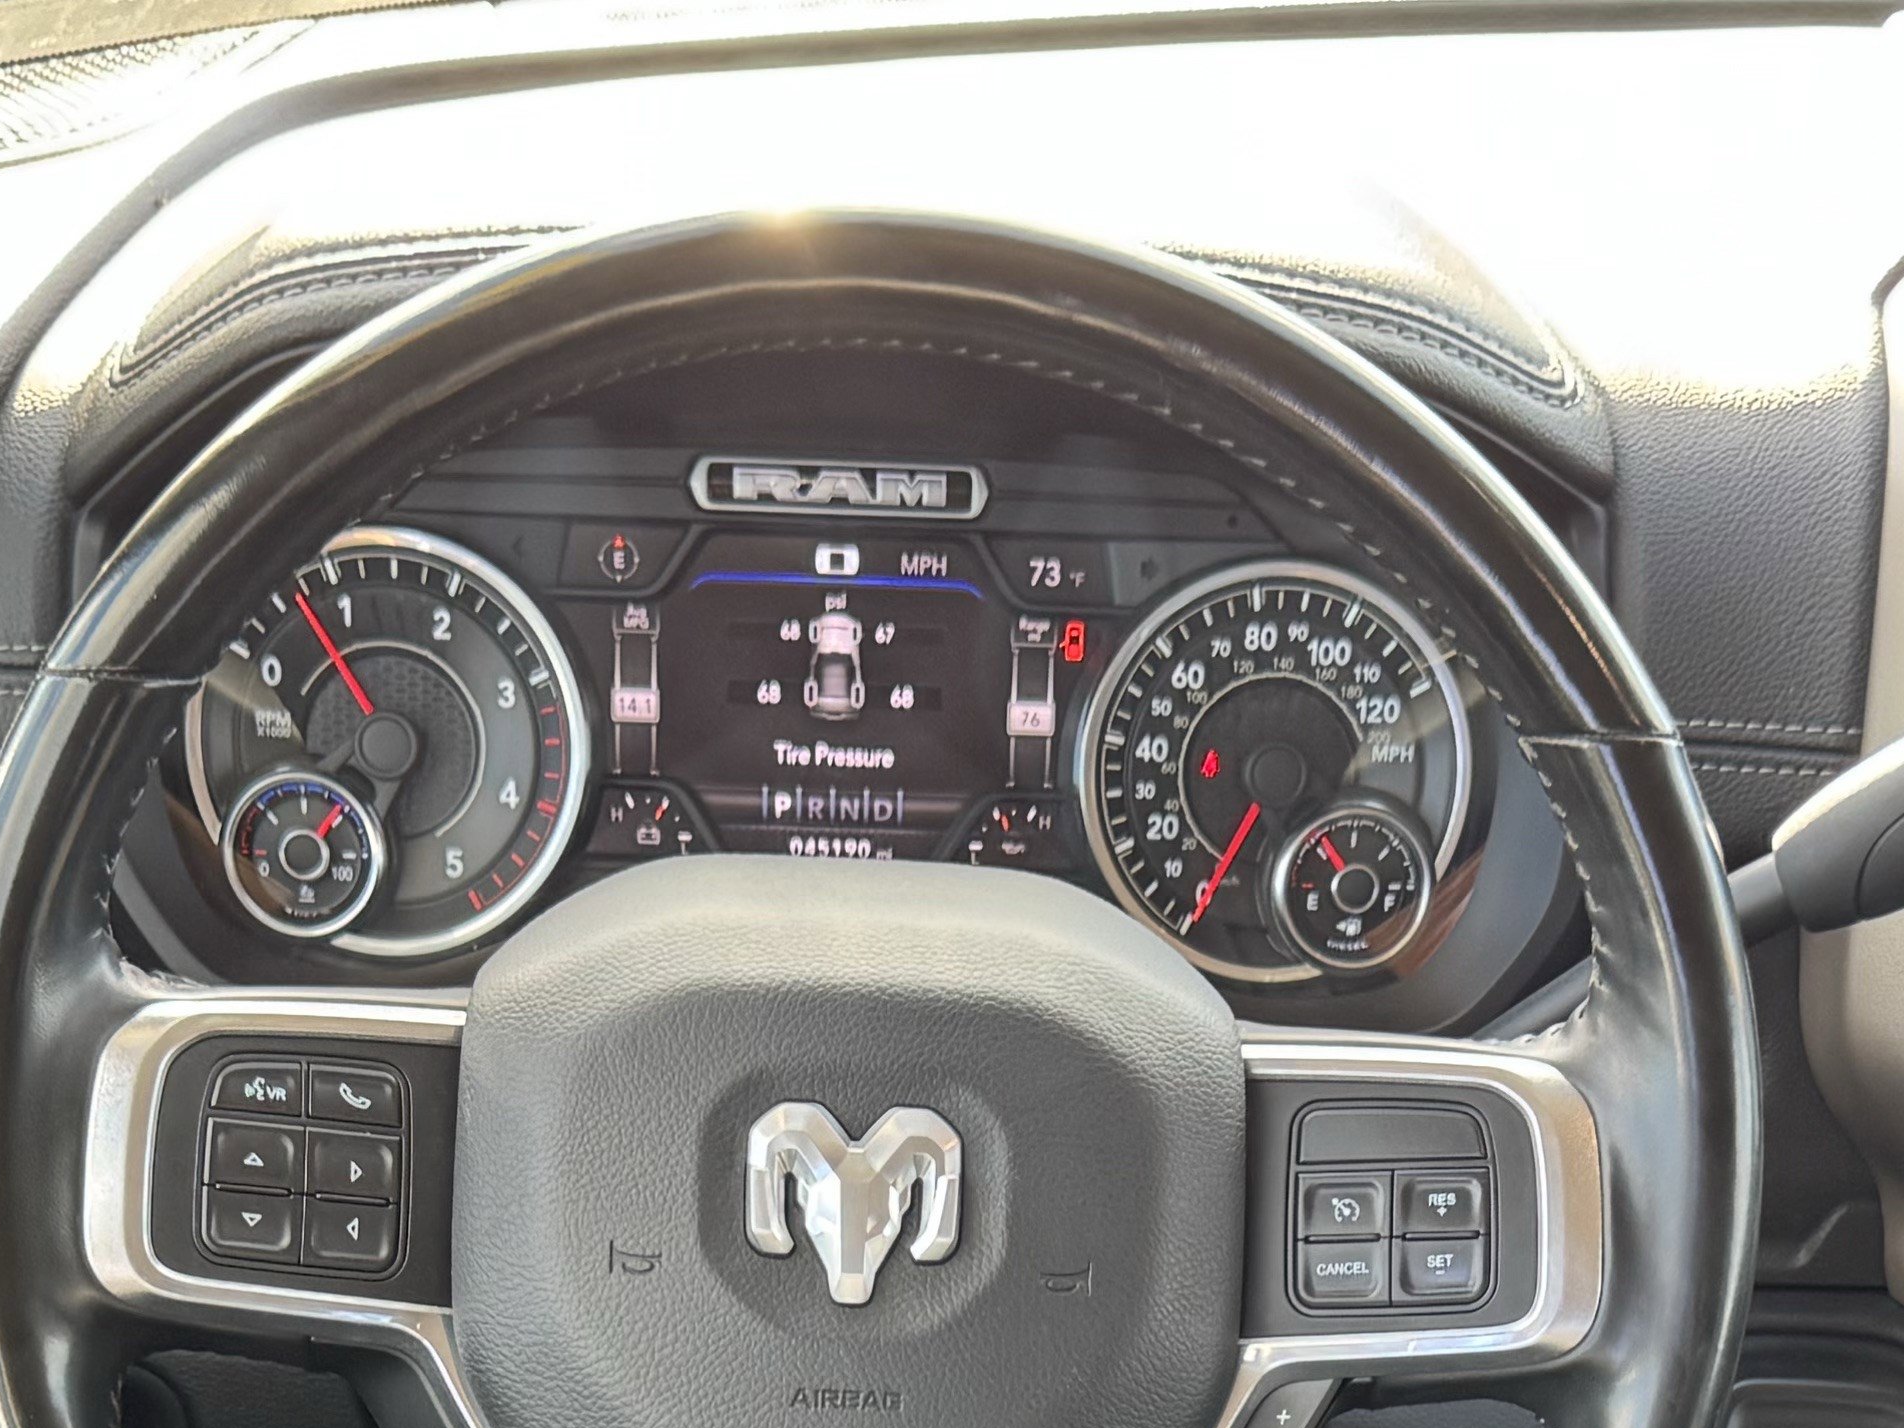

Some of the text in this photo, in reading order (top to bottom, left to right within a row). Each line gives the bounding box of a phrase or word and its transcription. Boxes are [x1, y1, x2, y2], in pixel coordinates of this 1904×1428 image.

[732, 465, 947, 508] RAM
[613, 551, 626, 570] E
[900, 551, 948, 578] MPH
[1029, 556, 1061, 588] 73
[337, 593, 352, 628] 1
[432, 605, 452, 641] 2
[780, 619, 896, 645] 68 67
[1244, 620, 1279, 652] 80
[1287, 619, 1310, 642] 90
[1210, 635, 1232, 658] 70
[1307, 635, 1353, 668] 100
[260, 654, 282, 687] 0
[1171, 660, 1206, 690] 60
[1353, 661, 1382, 684] 110
[497, 676, 516, 709] 3
[757, 679, 915, 710] 68 68
[1151, 695, 1173, 717] 50
[1022, 709, 1041, 729] 76
[1356, 693, 1401, 725] 120
[773, 738, 895, 769] Tire Pressure
[1135, 733, 1169, 763] 40
[1371, 743, 1416, 764] MPH
[498, 779, 520, 810] 4
[1134, 779, 1156, 800] 30
[774, 790, 893, 823] P R N D
[1146, 811, 1179, 841] 20
[257, 861, 270, 878] 0
[331, 865, 354, 883] 100
[445, 848, 464, 879] 5
[1163, 857, 1183, 879] 10
[1306, 890, 1396, 912] E F
[265, 1084, 287, 1102] VR
[1427, 1192, 1457, 1208] RES
[1315, 1260, 1370, 1277] CANCEL
[1426, 1253, 1454, 1268] SET
